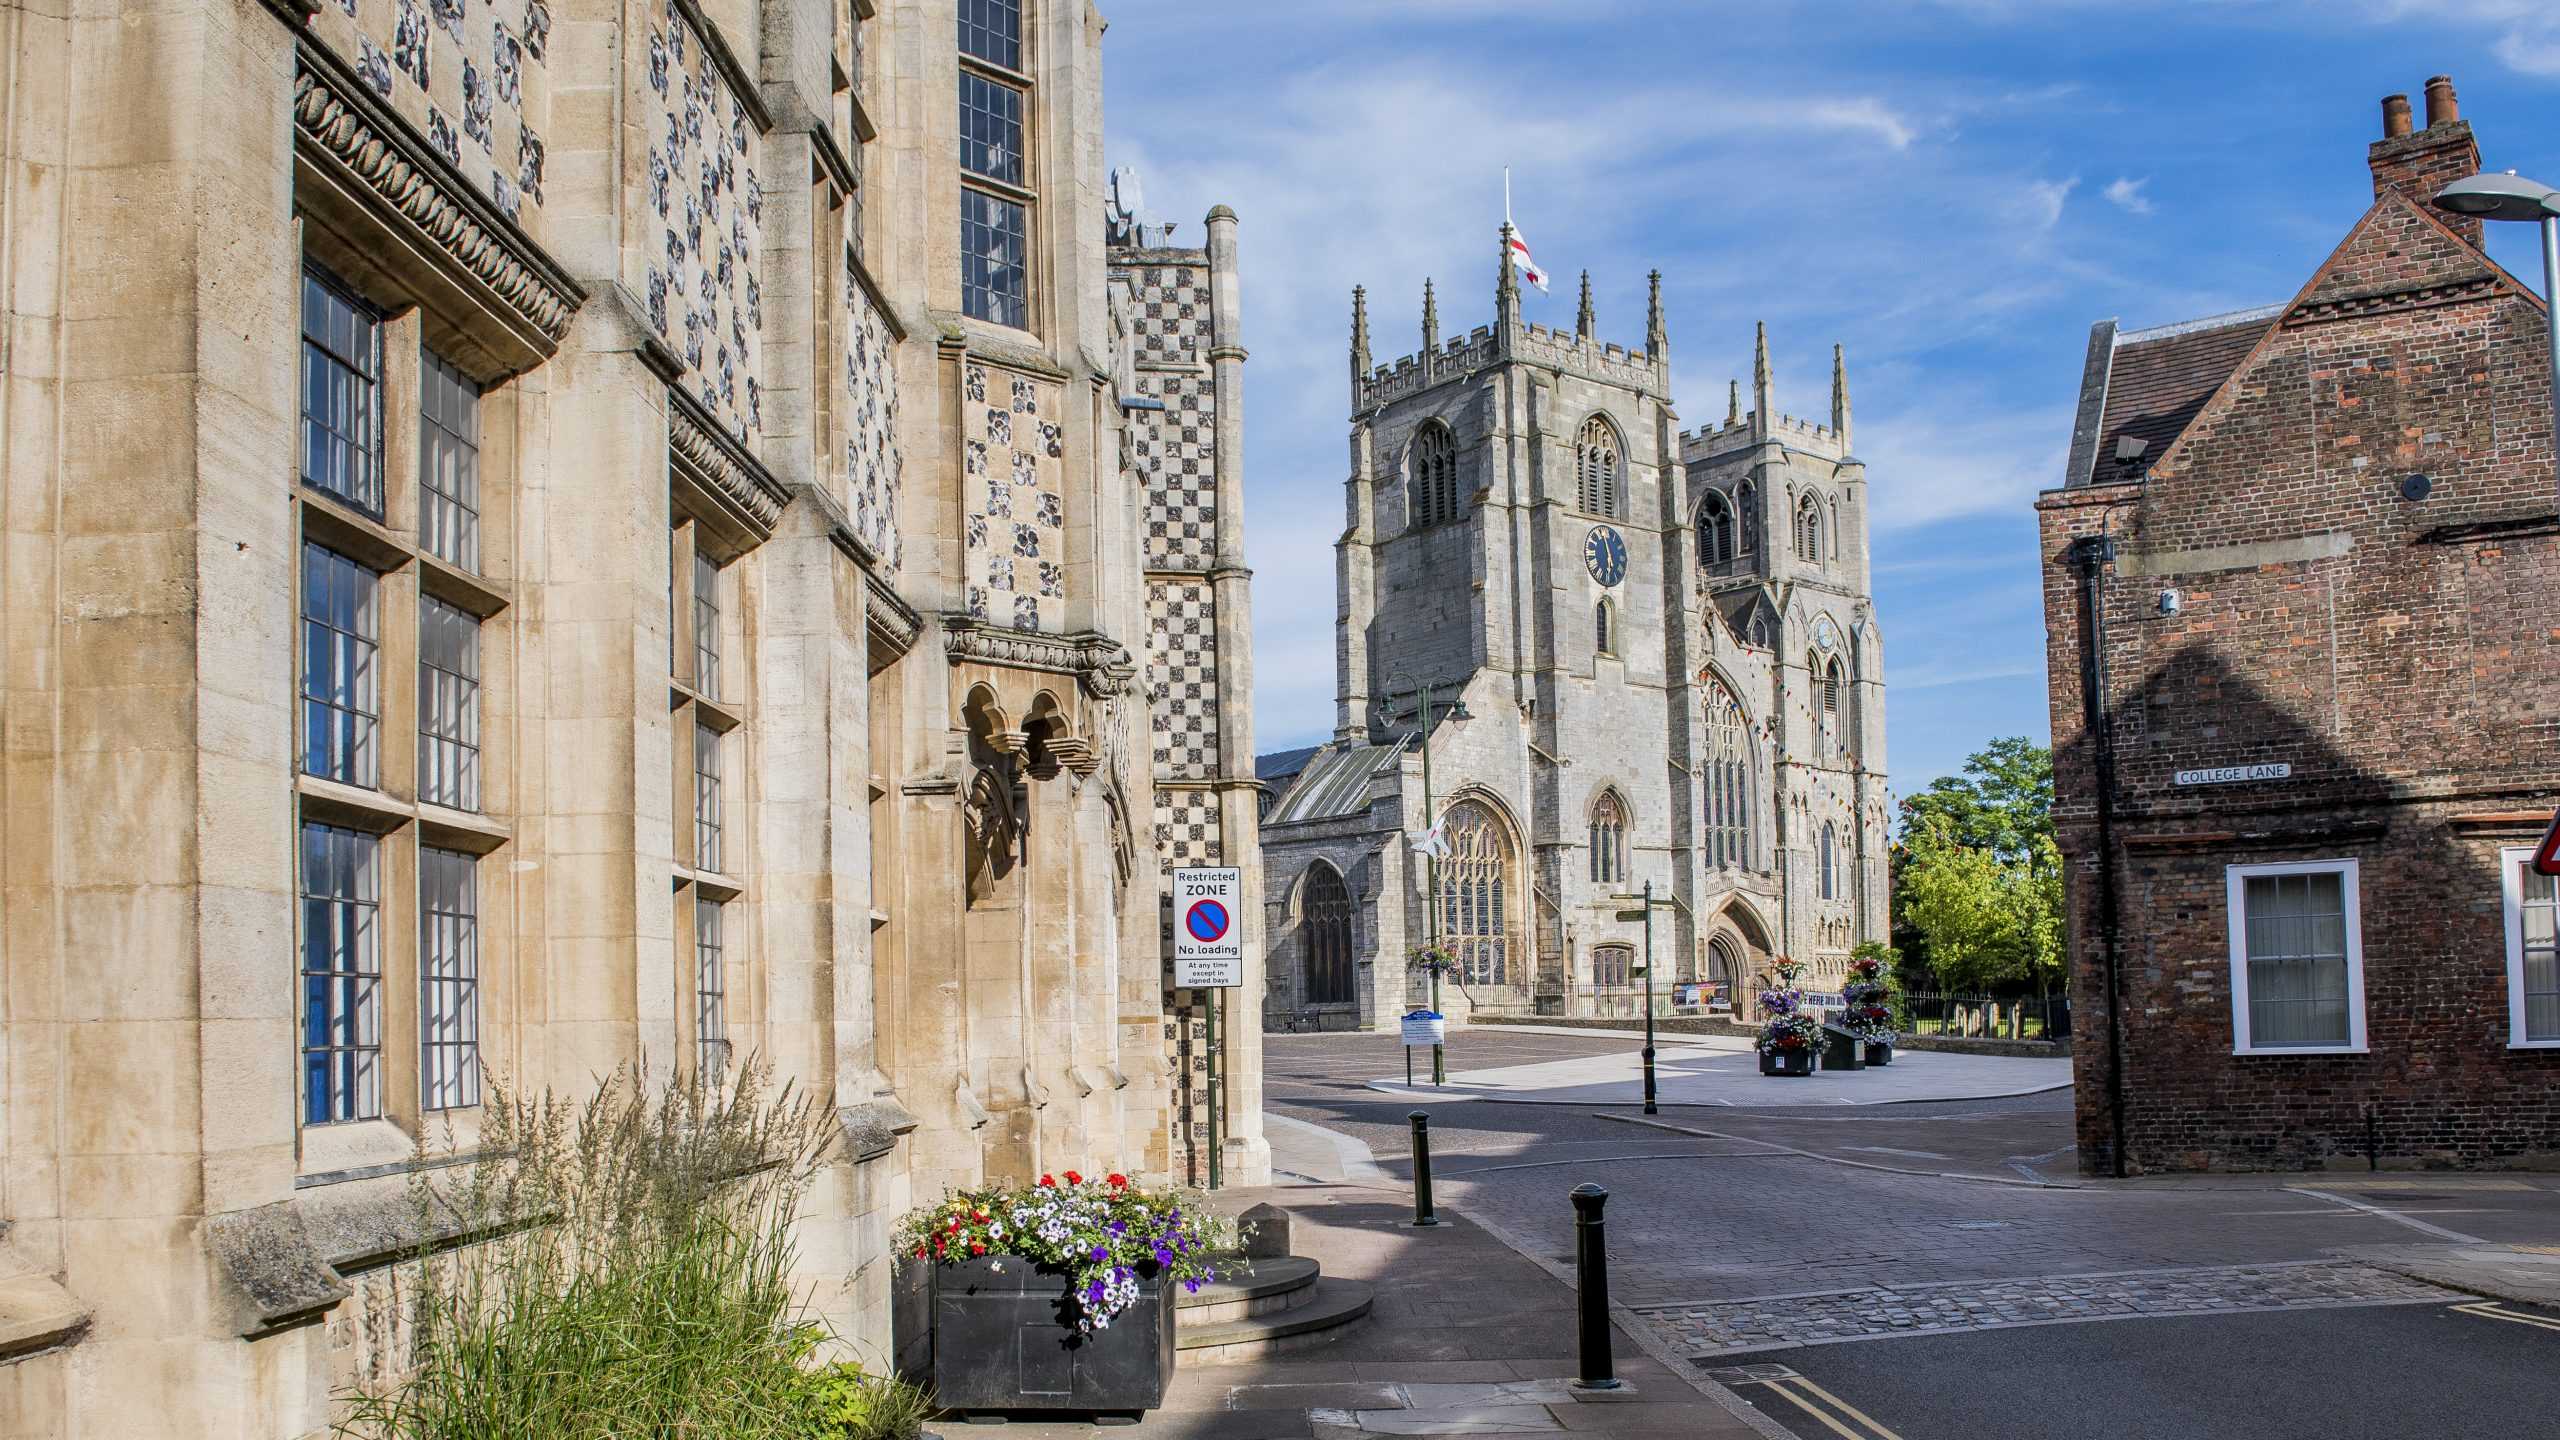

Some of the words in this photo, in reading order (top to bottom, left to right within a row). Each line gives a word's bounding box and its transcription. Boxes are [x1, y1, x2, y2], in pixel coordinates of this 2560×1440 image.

[2180, 768, 2241, 783] COLLEGE
[2246, 765, 2285, 779] LANE
[1178, 872, 1235, 881] Restricted
[1186, 885, 1227, 896] ZONE
[1178, 945, 1194, 954] No
[1198, 945, 1238, 955] loading
